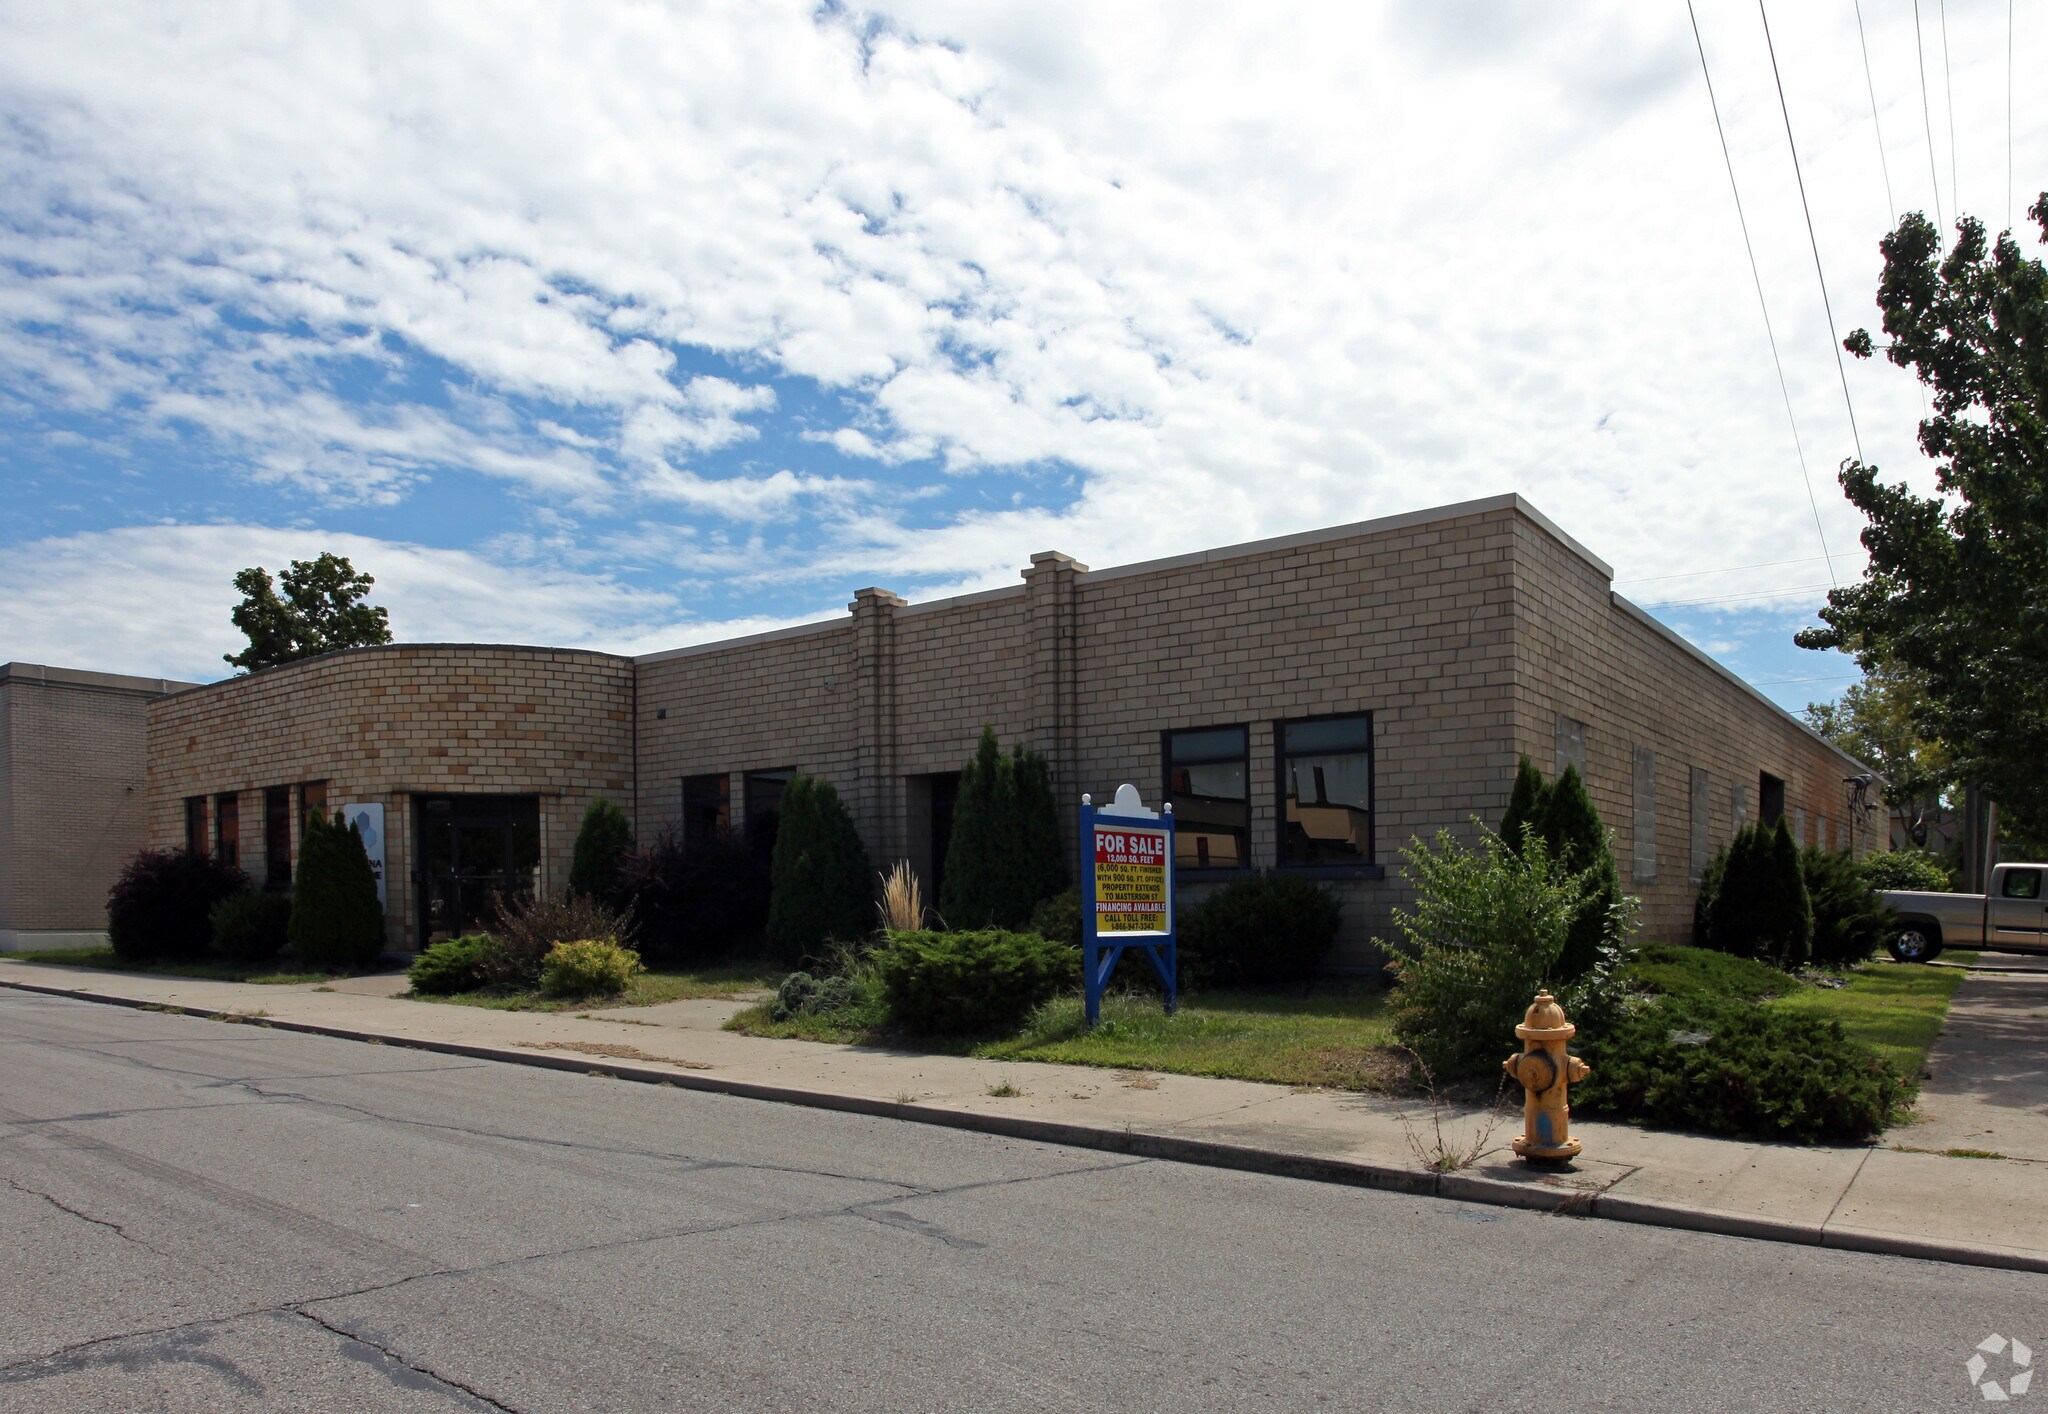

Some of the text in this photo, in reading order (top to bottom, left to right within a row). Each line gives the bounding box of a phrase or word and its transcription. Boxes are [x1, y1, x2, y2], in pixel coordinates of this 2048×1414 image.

[1096, 834, 1163, 854] FOR SALE
[1107, 854, 1127, 862] 12,000
[1098, 864, 1118, 872] (6,000
[1096, 902, 1165, 912] FINANCING AVAILABLE
[1104, 914, 1121, 922] CALL
[1141, 914, 1158, 922] FREE:
